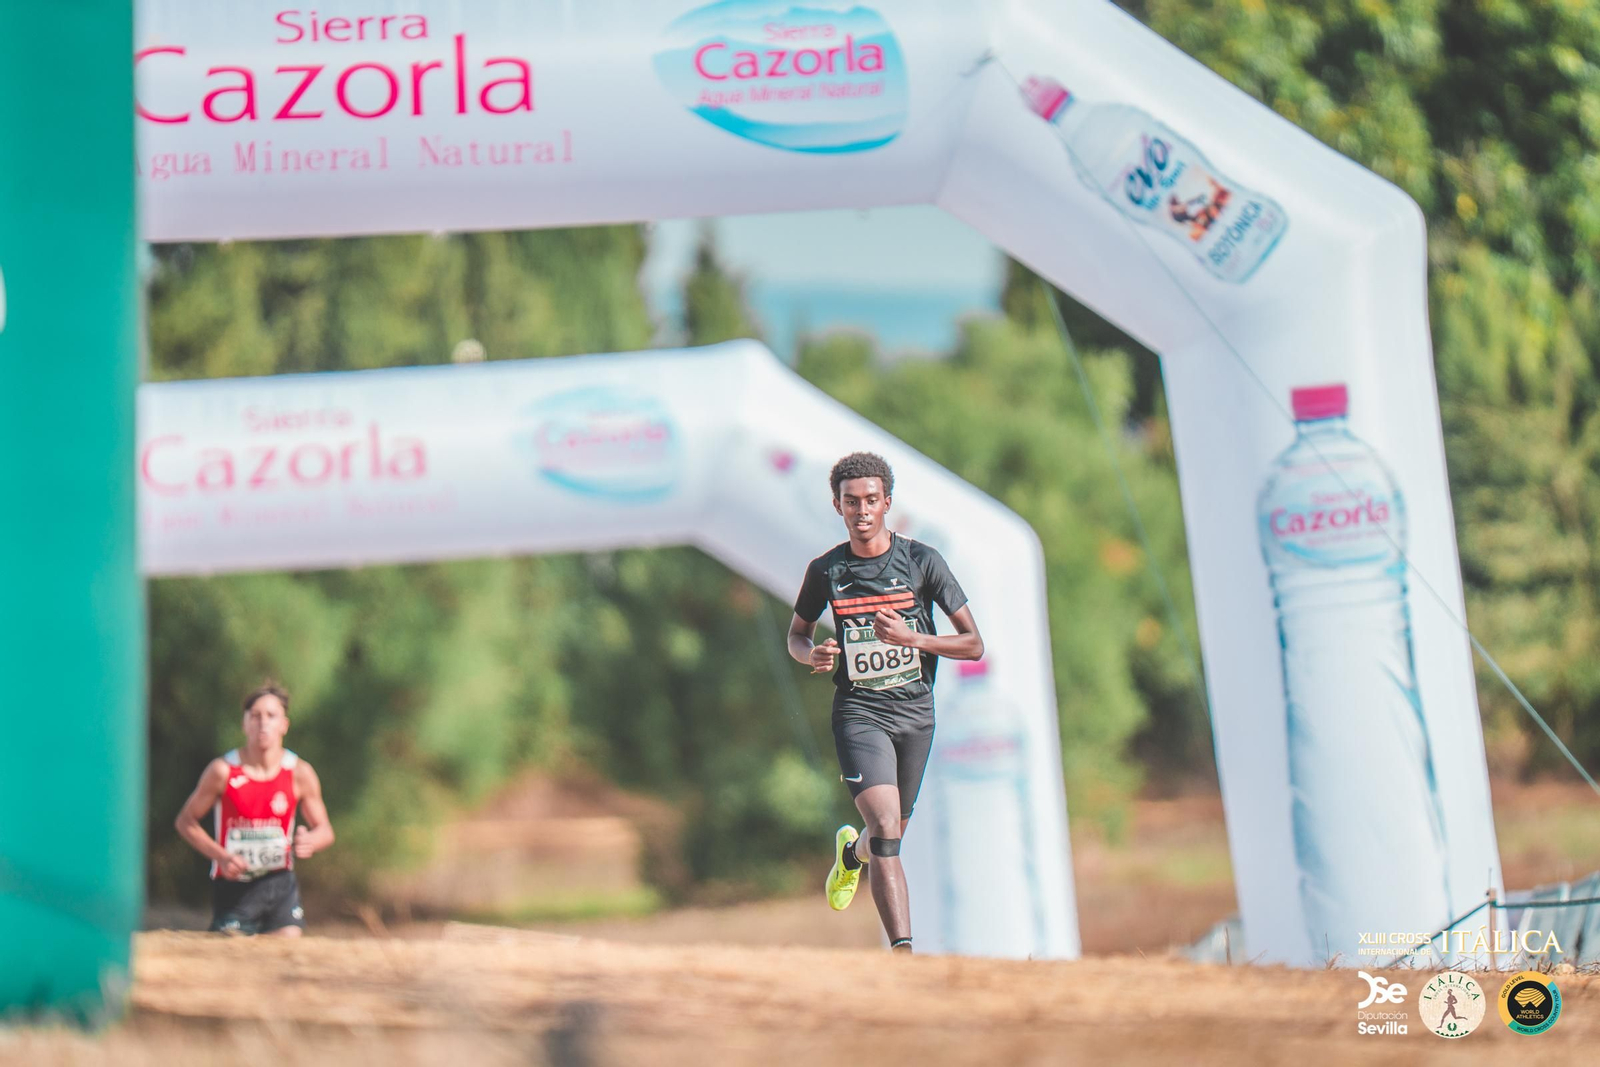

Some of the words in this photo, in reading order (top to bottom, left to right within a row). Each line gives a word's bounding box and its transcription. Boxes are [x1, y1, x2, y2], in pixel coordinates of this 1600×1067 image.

[274, 10, 429, 43] Sierra
[135, 34, 535, 124] Cazorla
[694, 33, 885, 81] Cazorla
[135, 149, 212, 181] gua
[234, 136, 390, 174] Mineral
[418, 130, 574, 168] Natural
[141, 420, 428, 498] Cazorla
[1269, 496, 1389, 538] Cazorla
[854, 645, 914, 674] 6089
